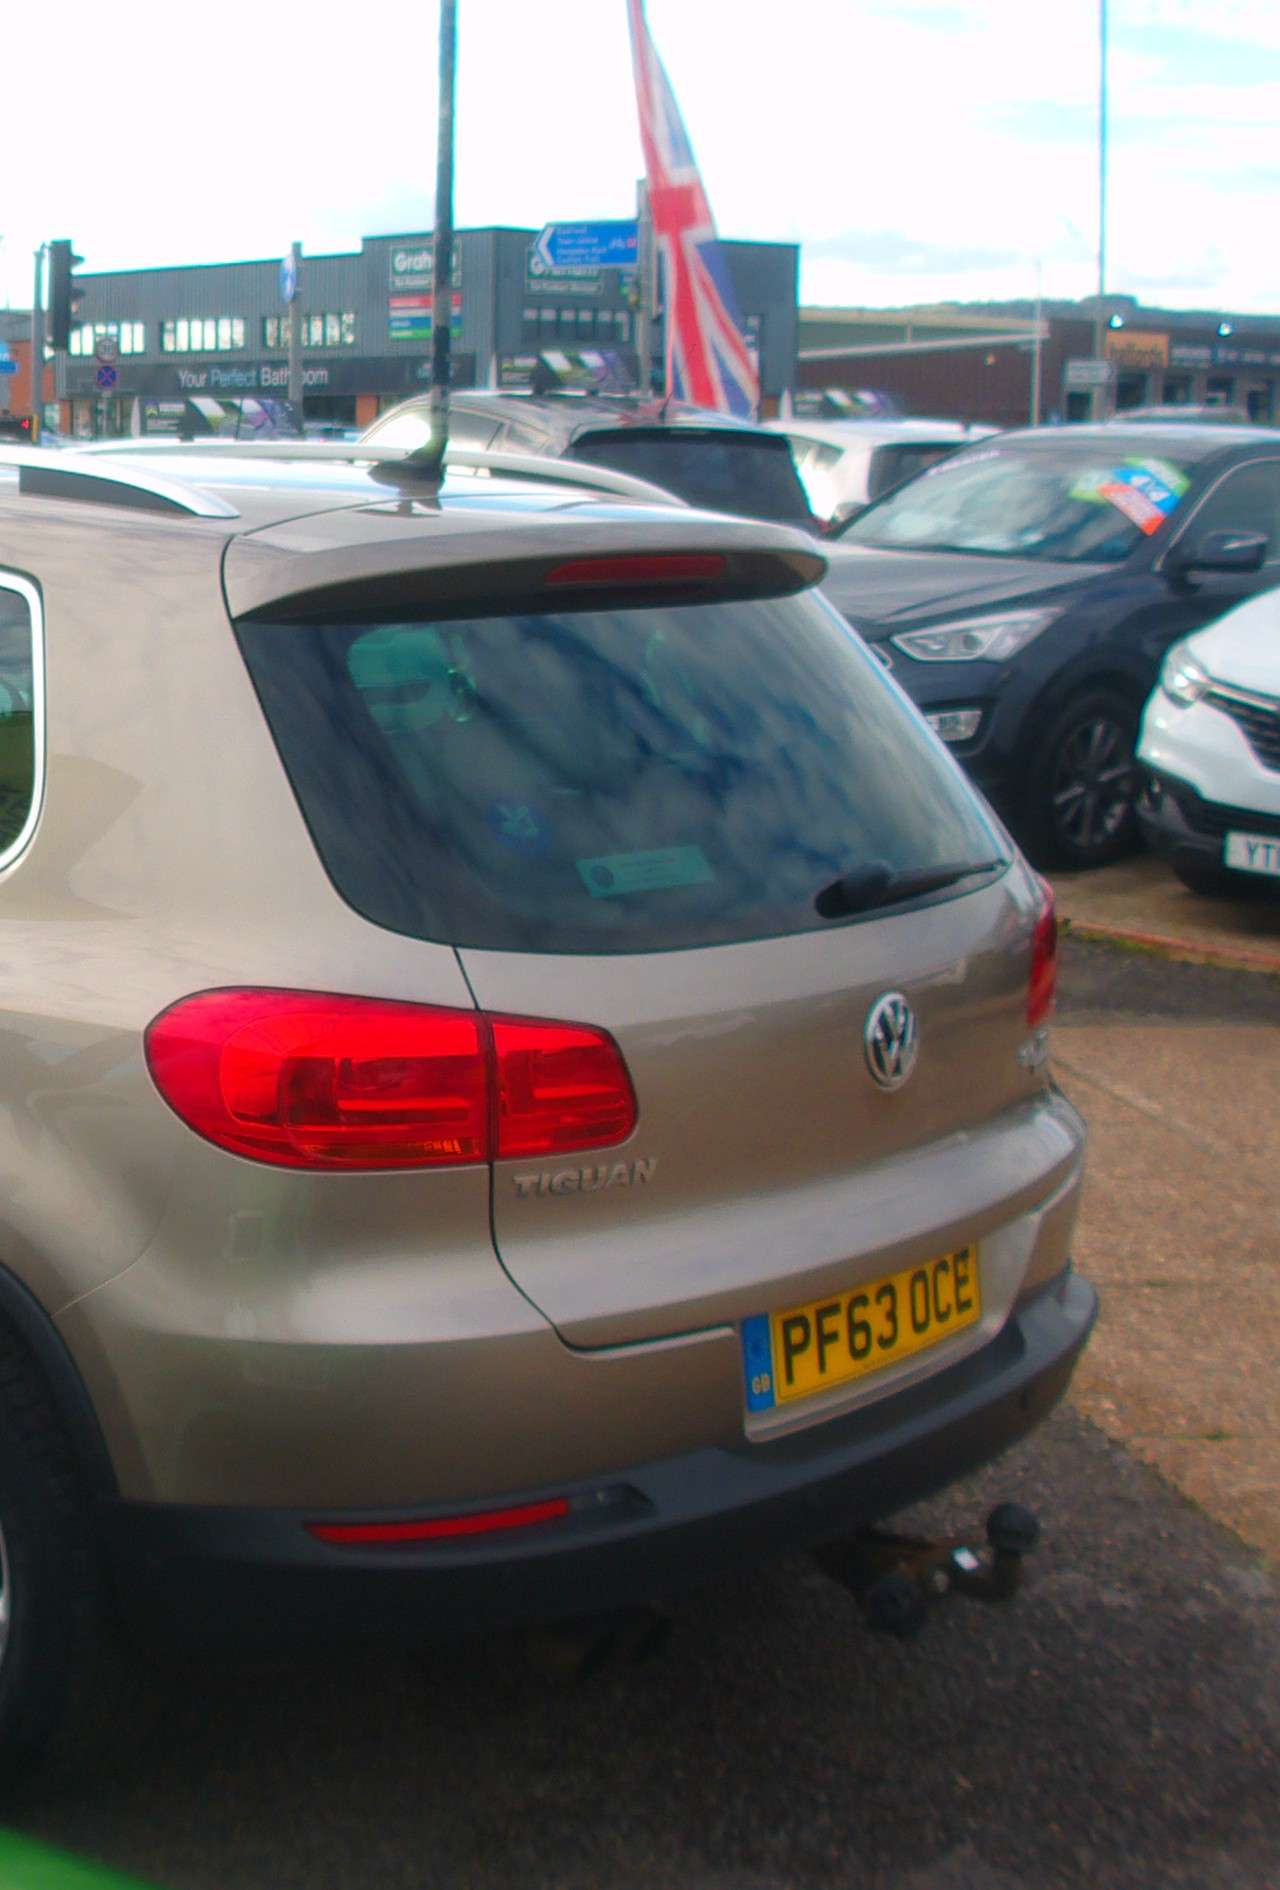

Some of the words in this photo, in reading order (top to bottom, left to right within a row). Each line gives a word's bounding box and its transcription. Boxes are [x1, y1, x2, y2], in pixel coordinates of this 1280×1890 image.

[179, 368, 207, 388] Your
[211, 367, 256, 387] Perfect
[513, 1158, 657, 1197] TIGUAN
[781, 1284, 898, 1385] PF63
[911, 1248, 973, 1334] OCE
[752, 1373, 770, 1394] GB
